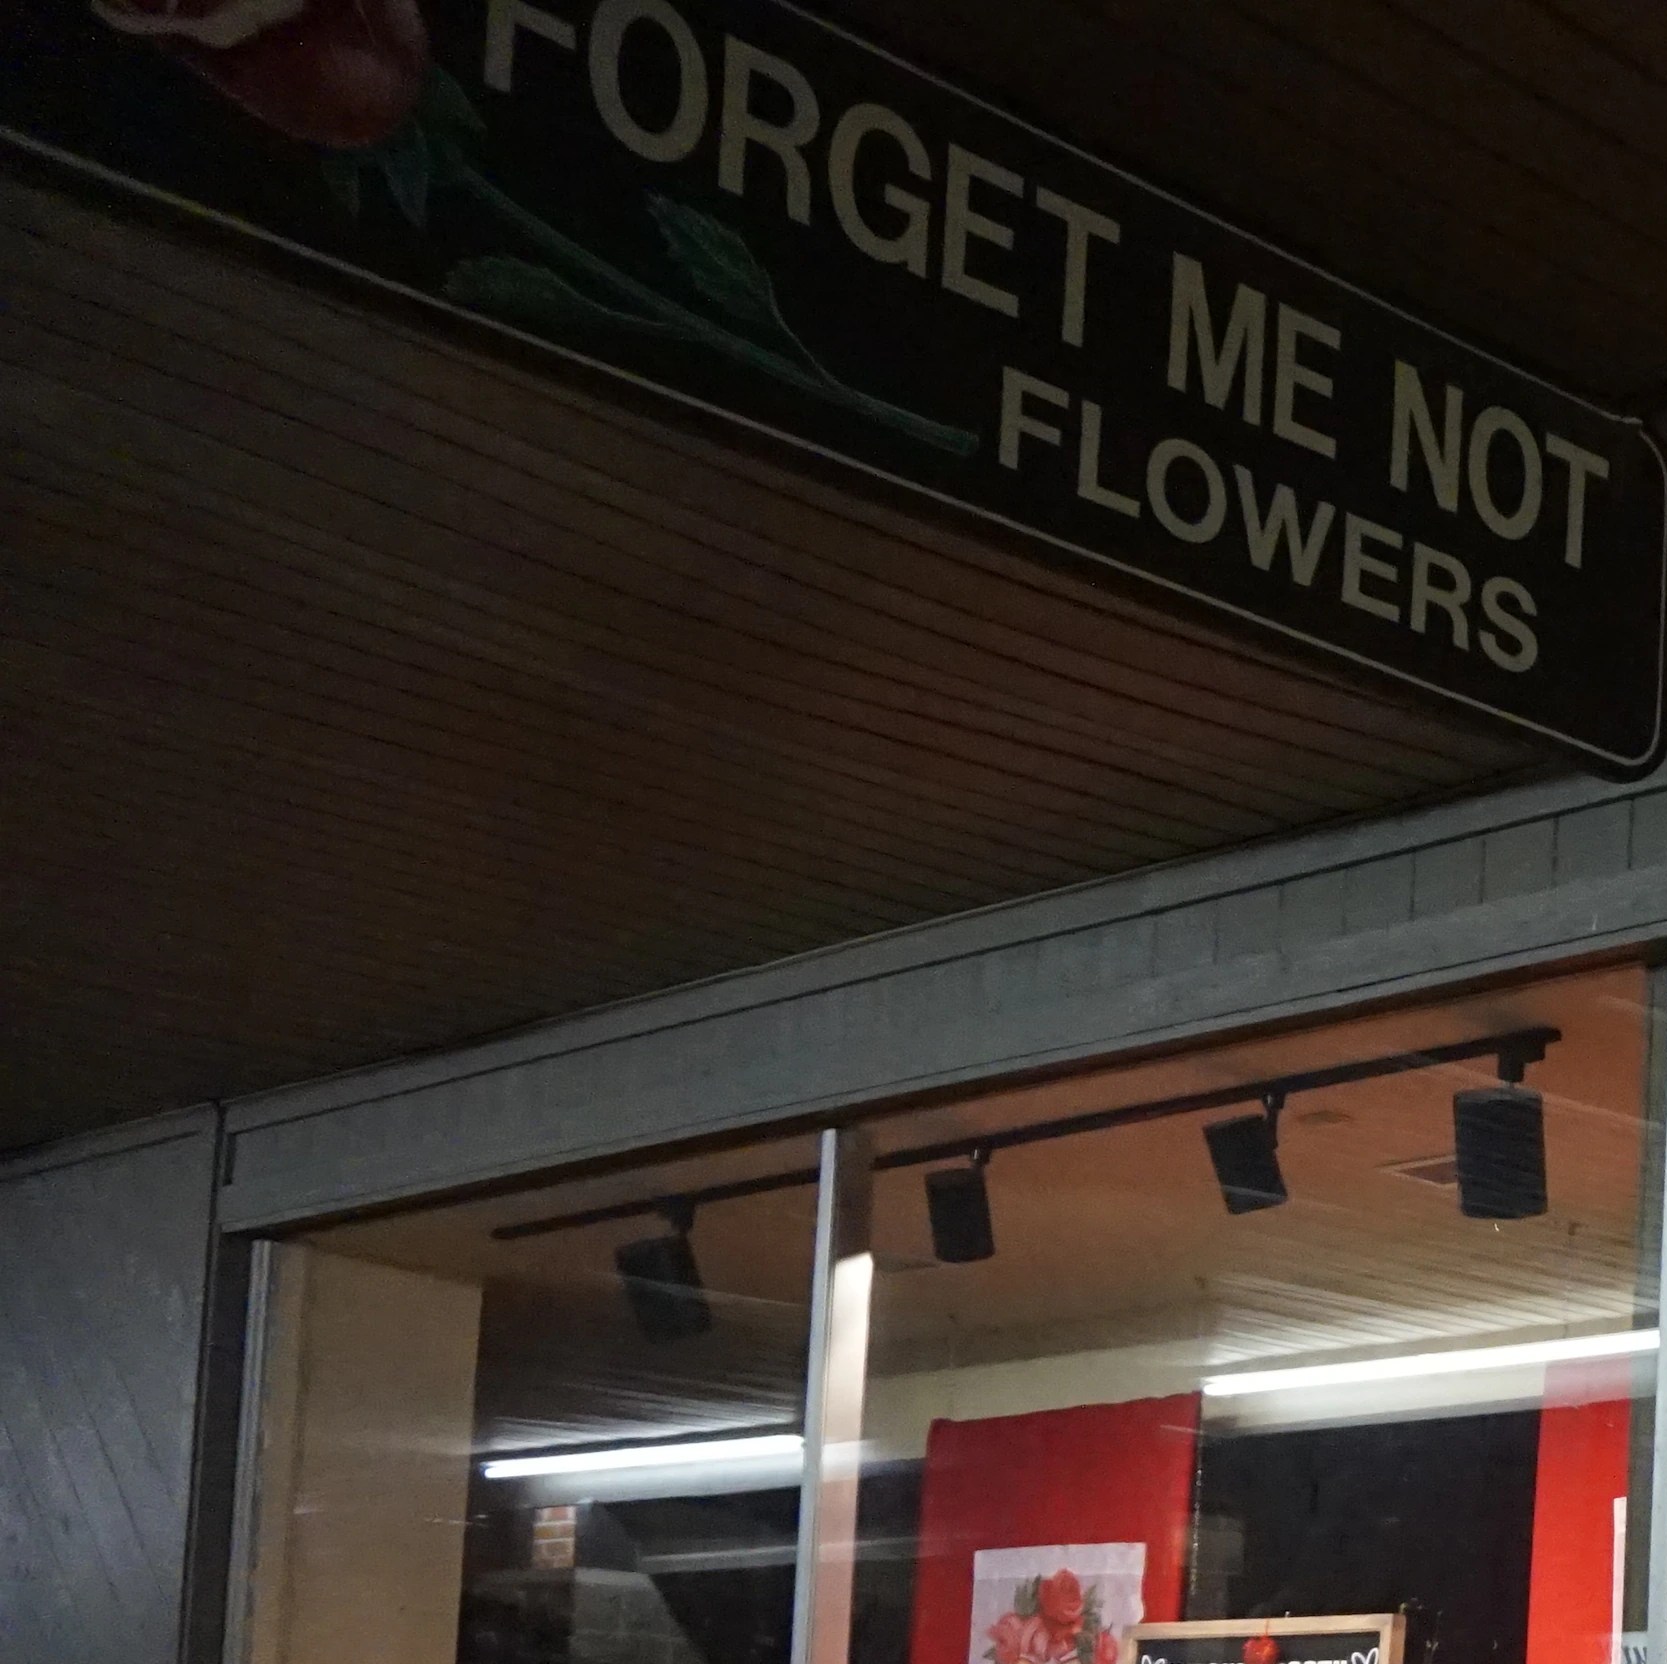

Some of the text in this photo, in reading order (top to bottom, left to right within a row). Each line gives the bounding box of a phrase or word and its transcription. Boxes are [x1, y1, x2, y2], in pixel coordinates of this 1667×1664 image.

[481, 0, 1611, 571] FORGET ME NOT
[996, 365, 1542, 676] FLOWERS
